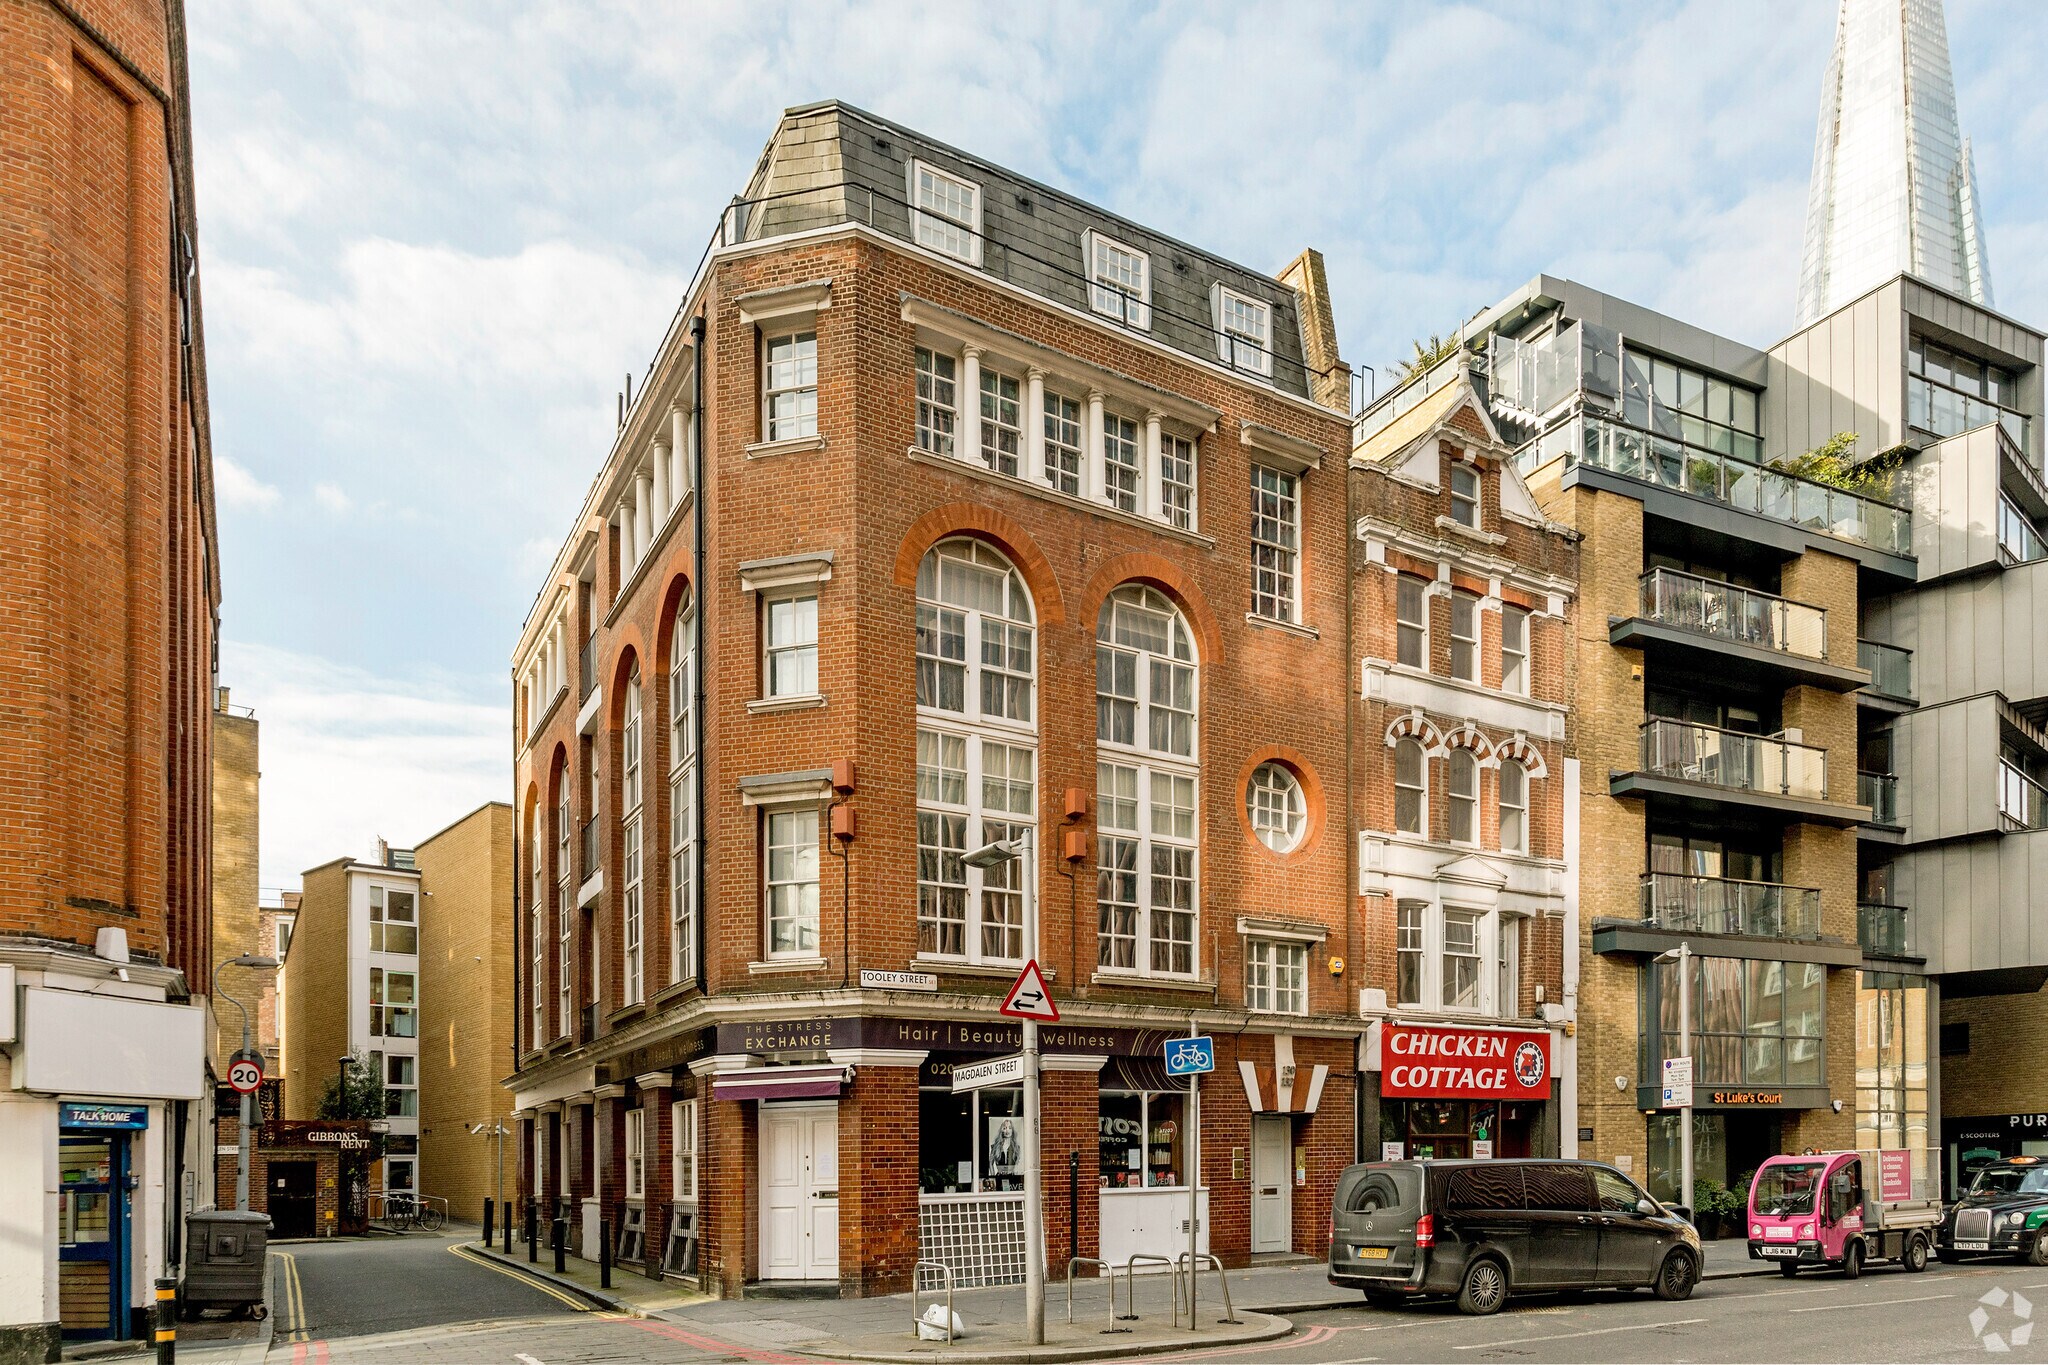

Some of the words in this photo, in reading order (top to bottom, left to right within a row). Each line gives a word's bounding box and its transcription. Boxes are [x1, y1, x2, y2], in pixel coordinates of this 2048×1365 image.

[862, 972, 897, 982] TOOLEY
[899, 974, 928, 985] STREET
[746, 1024, 771, 1034] THE
[777, 1022, 832, 1033] STRESS
[745, 1034, 832, 1049] EXCHANGE
[899, 1025, 939, 1041] Hair
[960, 1027, 1022, 1047] Beauty
[1042, 1032, 1115, 1047] Wellness
[1390, 1033, 1508, 1058] CHICKEN
[930, 1063, 954, 1075] 020
[954, 1066, 993, 1083] MAGDALEN
[994, 1060, 1018, 1075] STREET
[233, 1069, 258, 1084] 20
[1390, 1065, 1508, 1089] COTTAGE
[1714, 1092, 1724, 1104] St
[1727, 1092, 1755, 1104] Luke's
[1757, 1092, 1782, 1104] Court
[73, 1111, 101, 1121] TALK
[101, 1112, 131, 1122] HOME
[307, 1131, 358, 1142] GIBBONS
[340, 1139, 370, 1149] RENT
